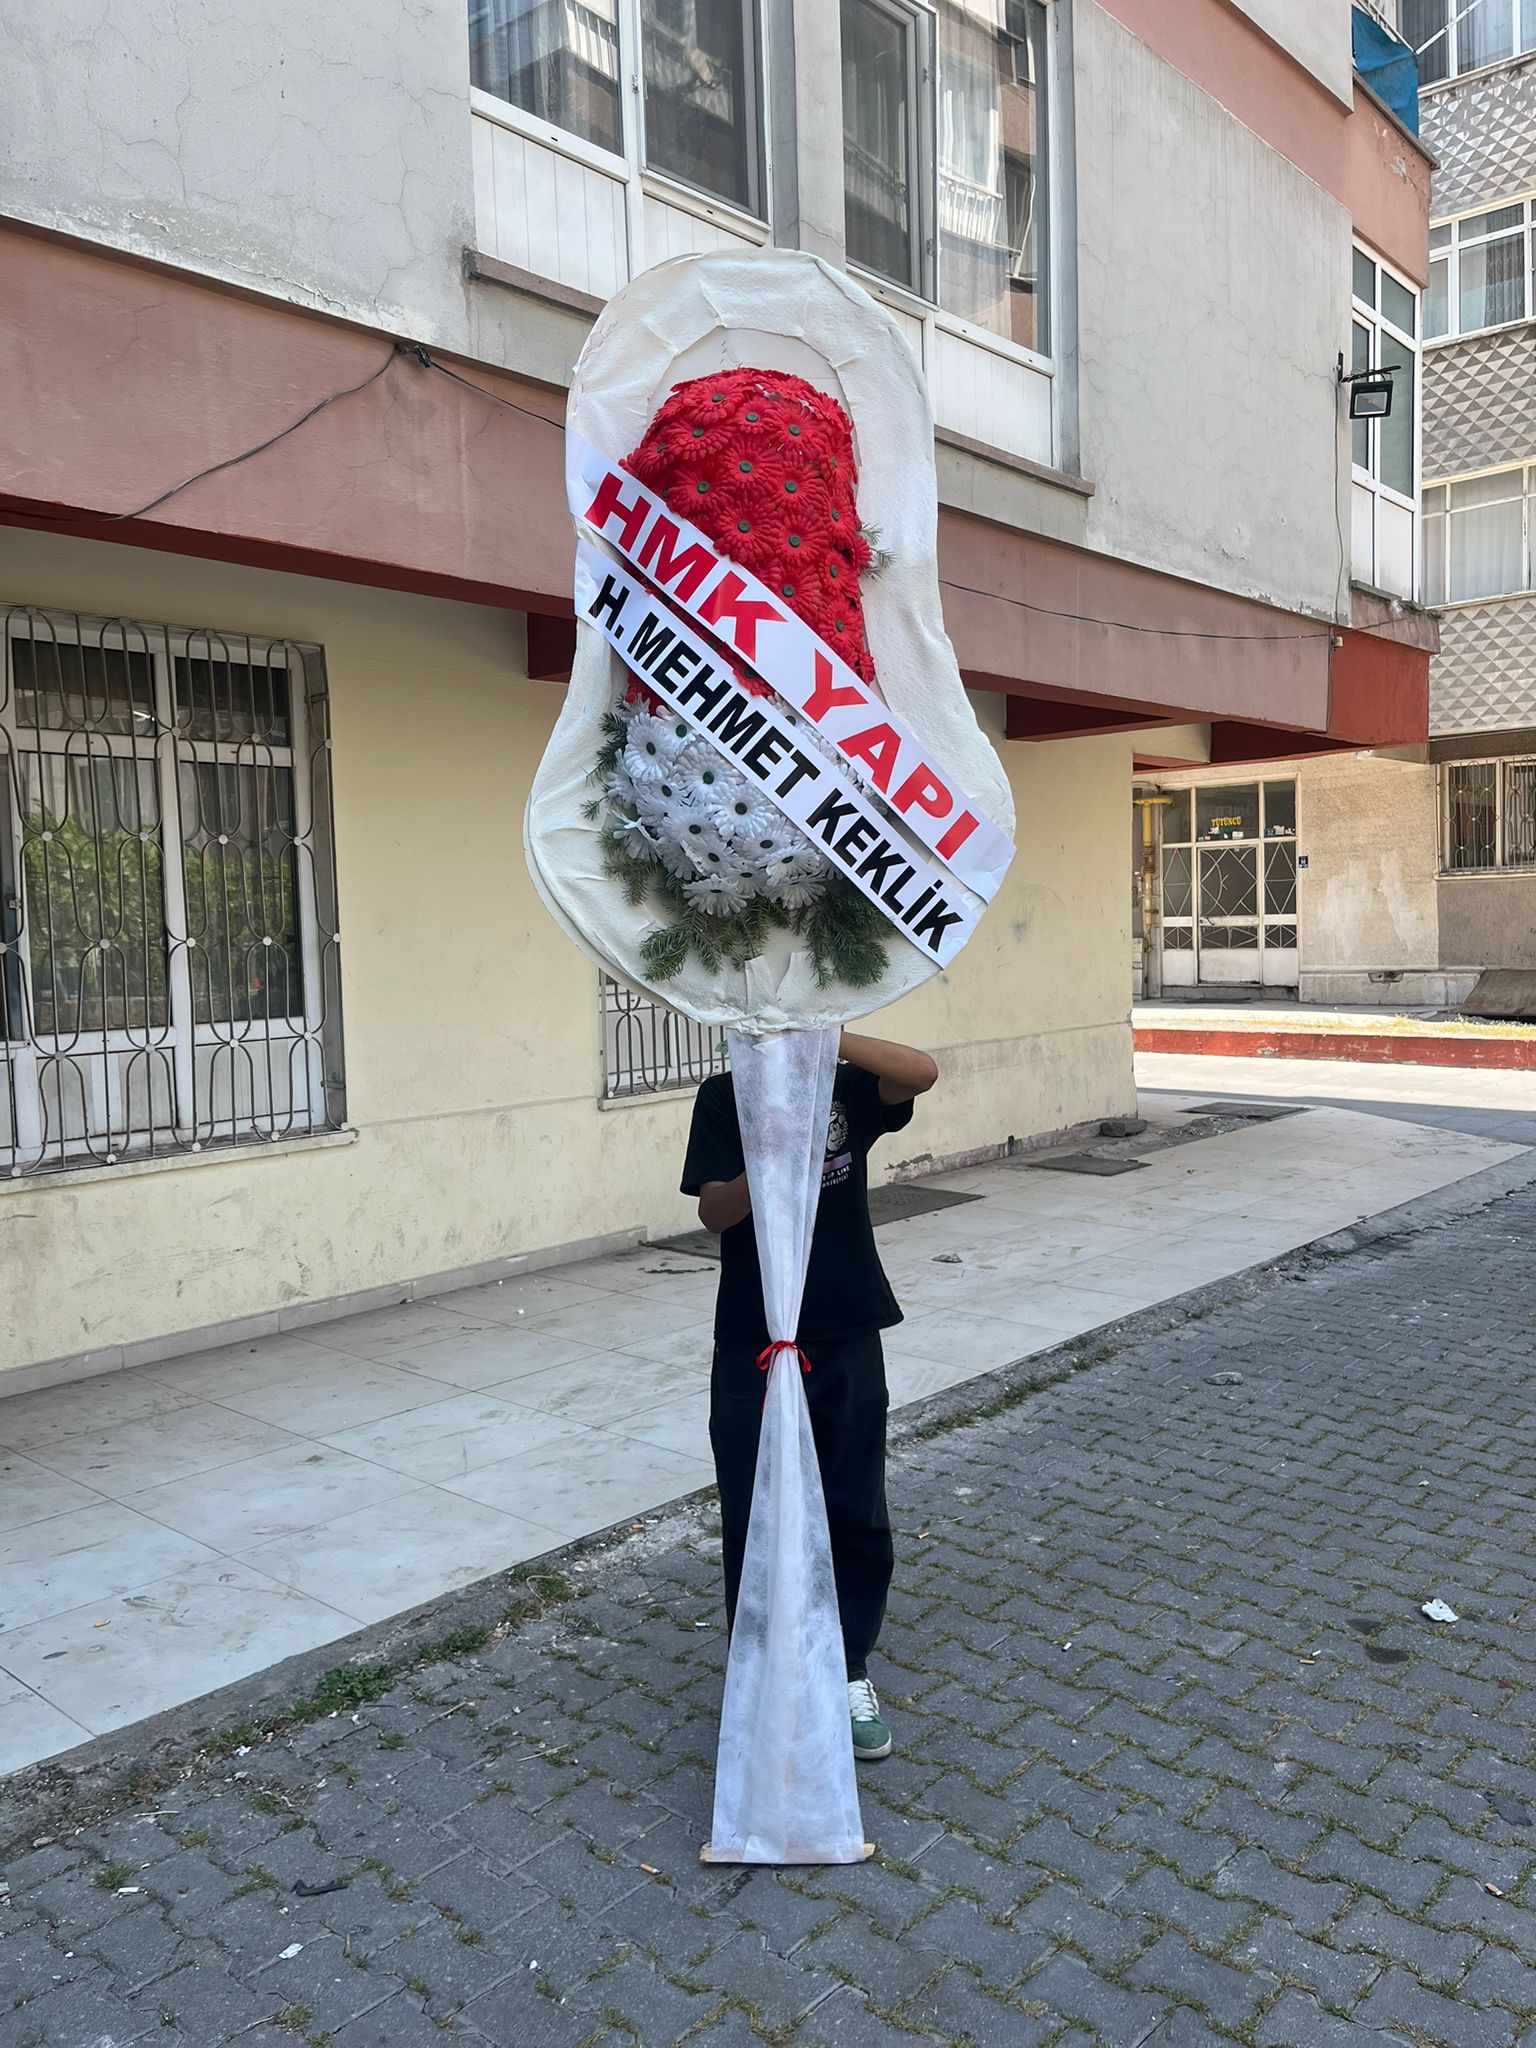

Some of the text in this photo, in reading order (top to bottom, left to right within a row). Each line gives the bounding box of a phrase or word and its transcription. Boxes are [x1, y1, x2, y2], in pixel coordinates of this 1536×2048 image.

[584, 472, 979, 860] HMK YAPI
[588, 574, 963, 952] H. MEHMET KEKLİK
